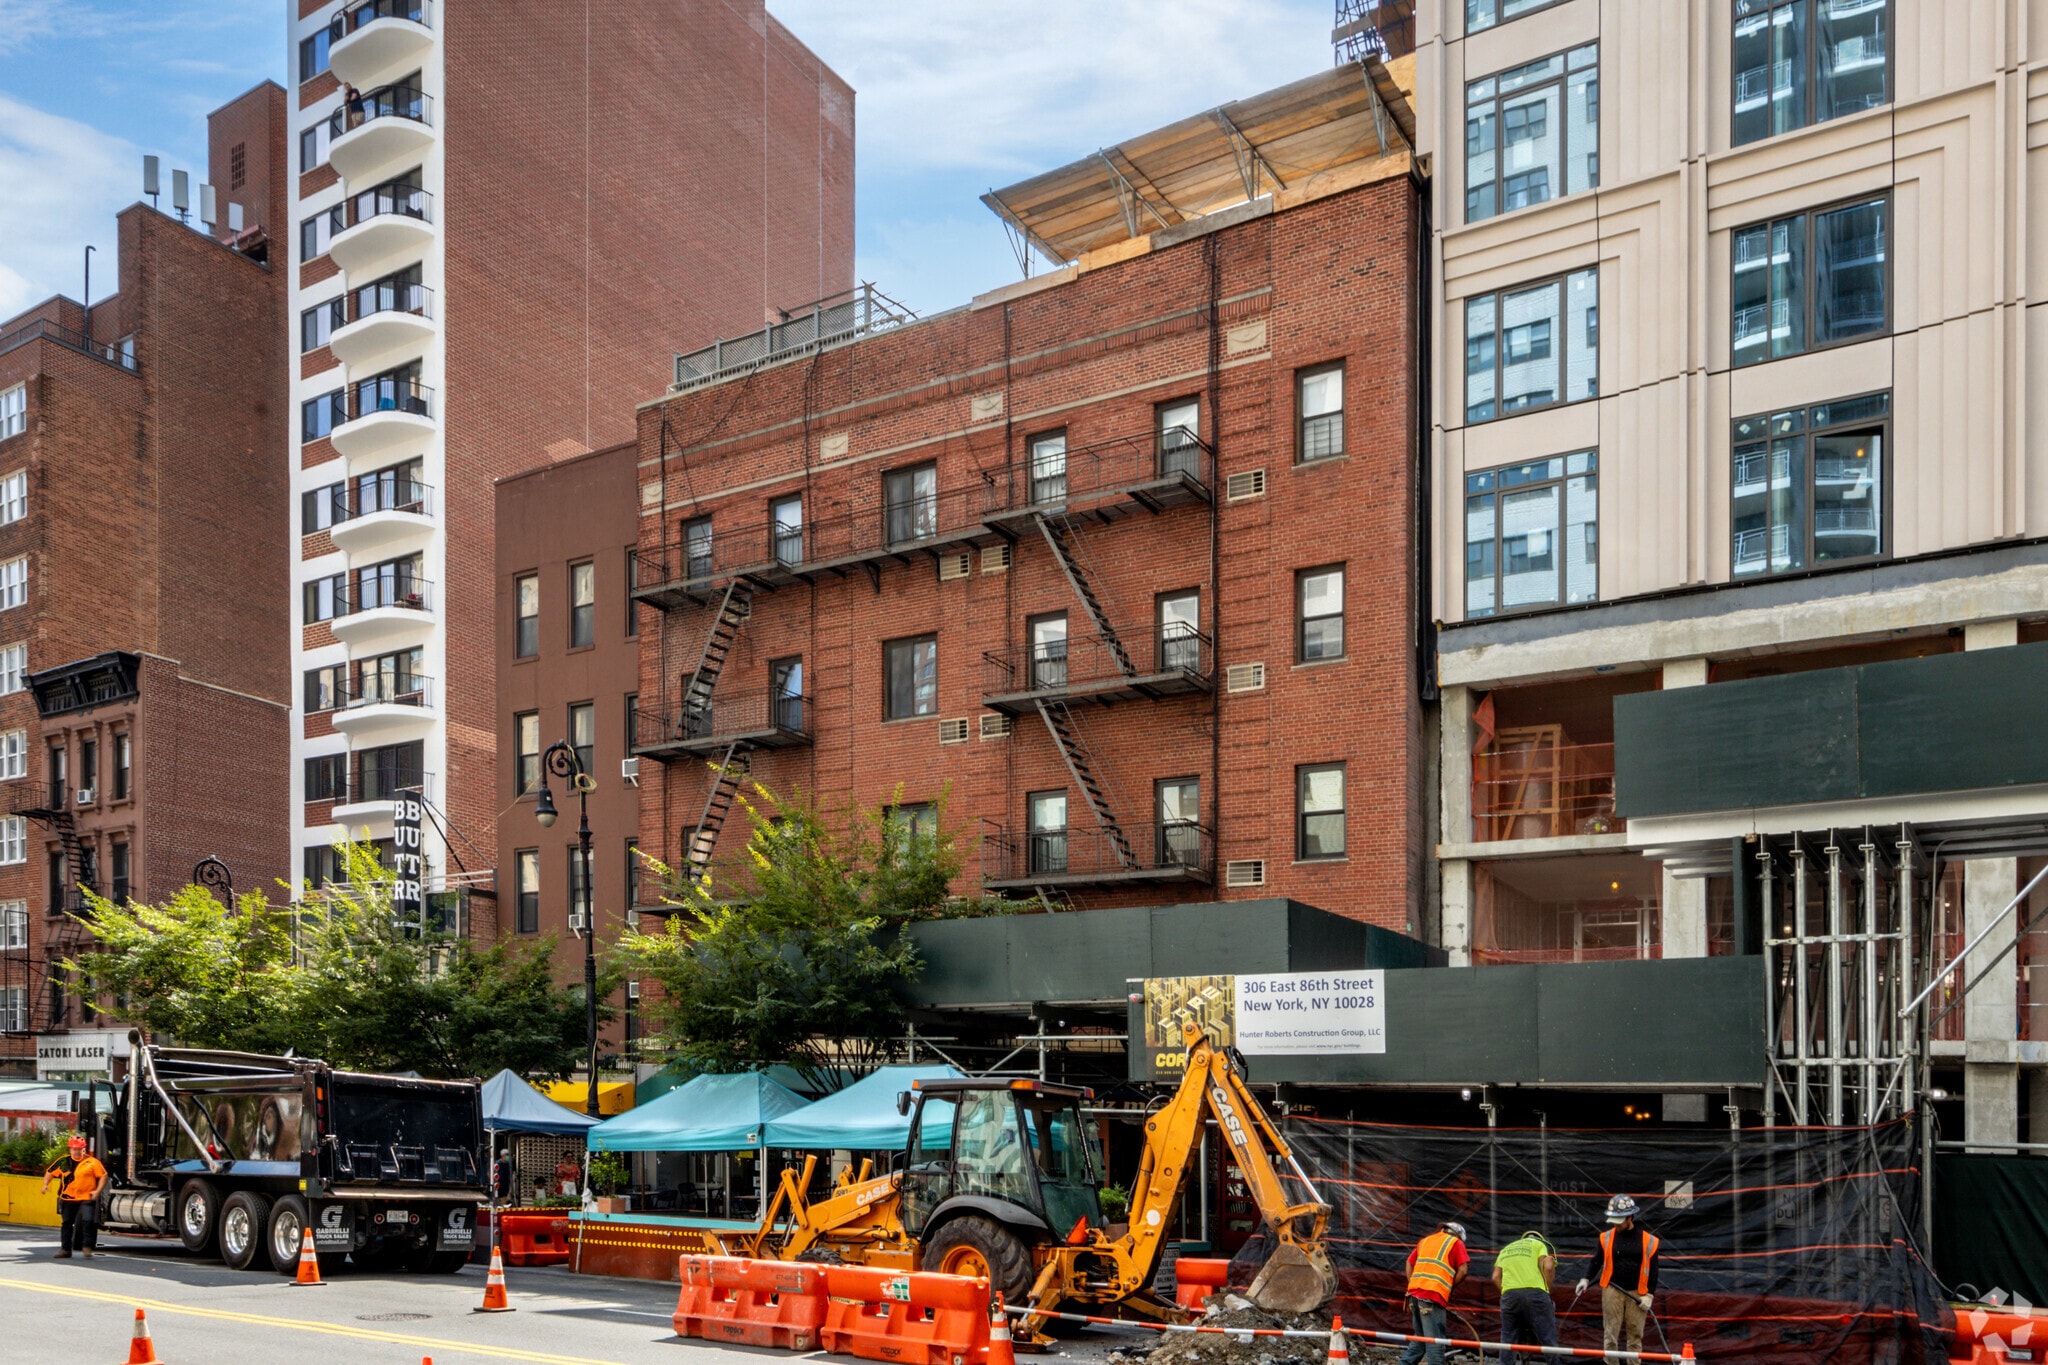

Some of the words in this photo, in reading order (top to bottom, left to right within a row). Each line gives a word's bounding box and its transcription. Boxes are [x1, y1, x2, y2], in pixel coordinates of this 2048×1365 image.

[1243, 981, 1267, 994] 306
[1270, 980, 1296, 992] East
[1299, 978, 1330, 992] 86th
[1333, 977, 1374, 991] Street
[1244, 1000, 1272, 1011] New
[1275, 997, 1308, 1012] York,
[1311, 997, 1330, 1010] NY
[1334, 996, 1375, 1009] 10028
[1264, 1030, 1293, 1038] Roberts
[1293, 1029, 1340, 1037] Construction
[1341, 1028, 1367, 1038] Group,
[1368, 1028, 1381, 1036] LLC
[38, 1047, 72, 1058] SATORI
[75, 1046, 105, 1058] LASER
[1212, 1086, 1249, 1147] CASE
[856, 1182, 890, 1206] CASE
[320, 1205, 344, 1228] G
[447, 1207, 468, 1229] G
